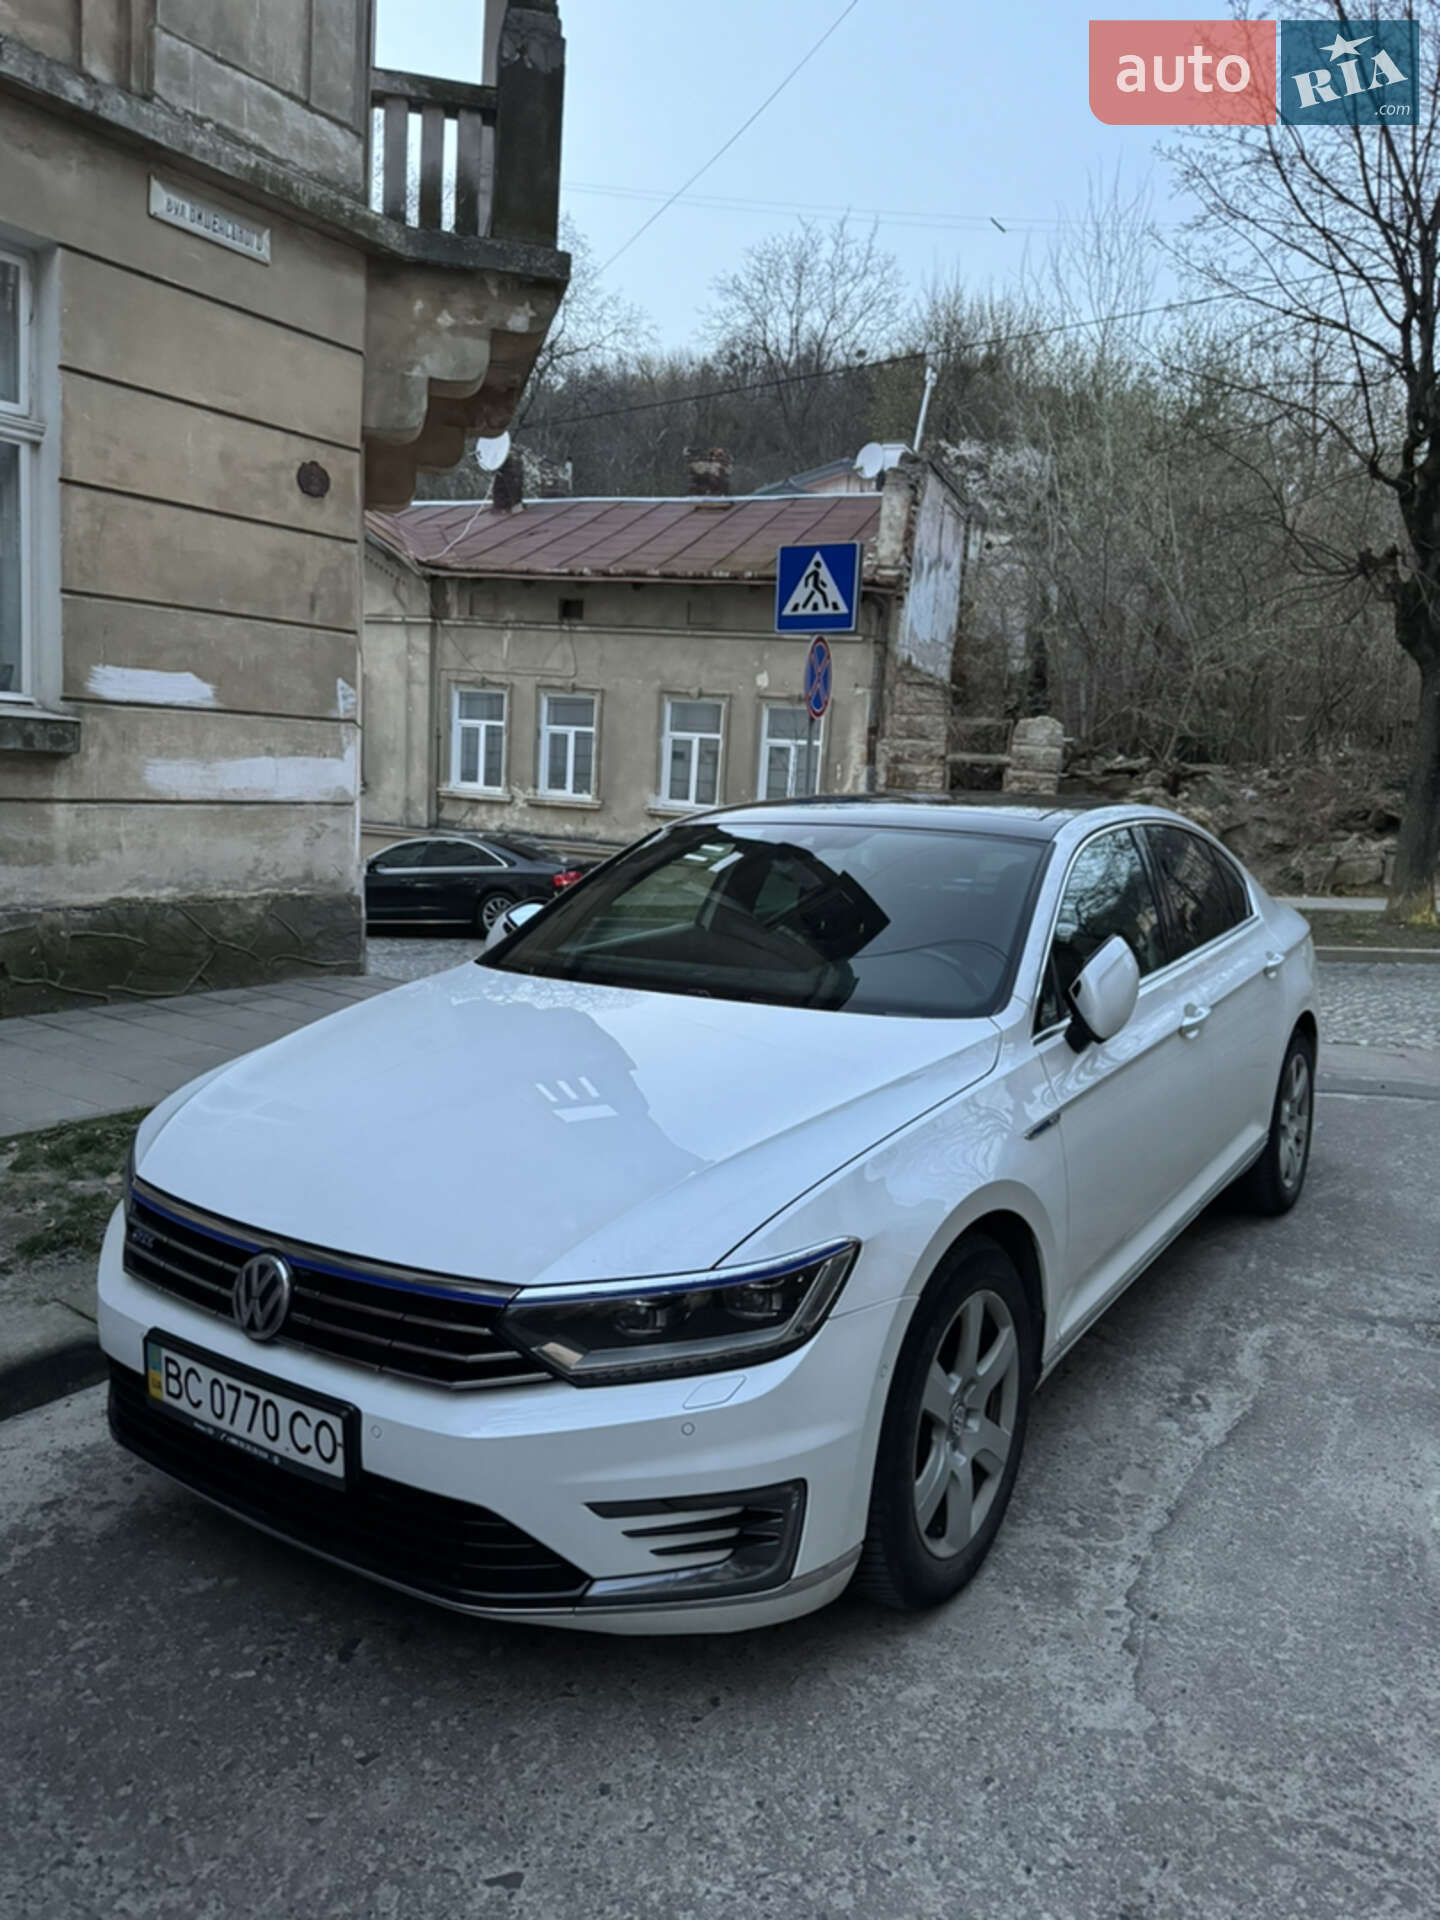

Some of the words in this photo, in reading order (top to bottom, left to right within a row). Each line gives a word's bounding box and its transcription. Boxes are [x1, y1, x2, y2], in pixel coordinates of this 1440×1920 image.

[164, 1355, 202, 1409] BC
[210, 1378, 279, 1442] 0770
[289, 1410, 337, 1464] CO
